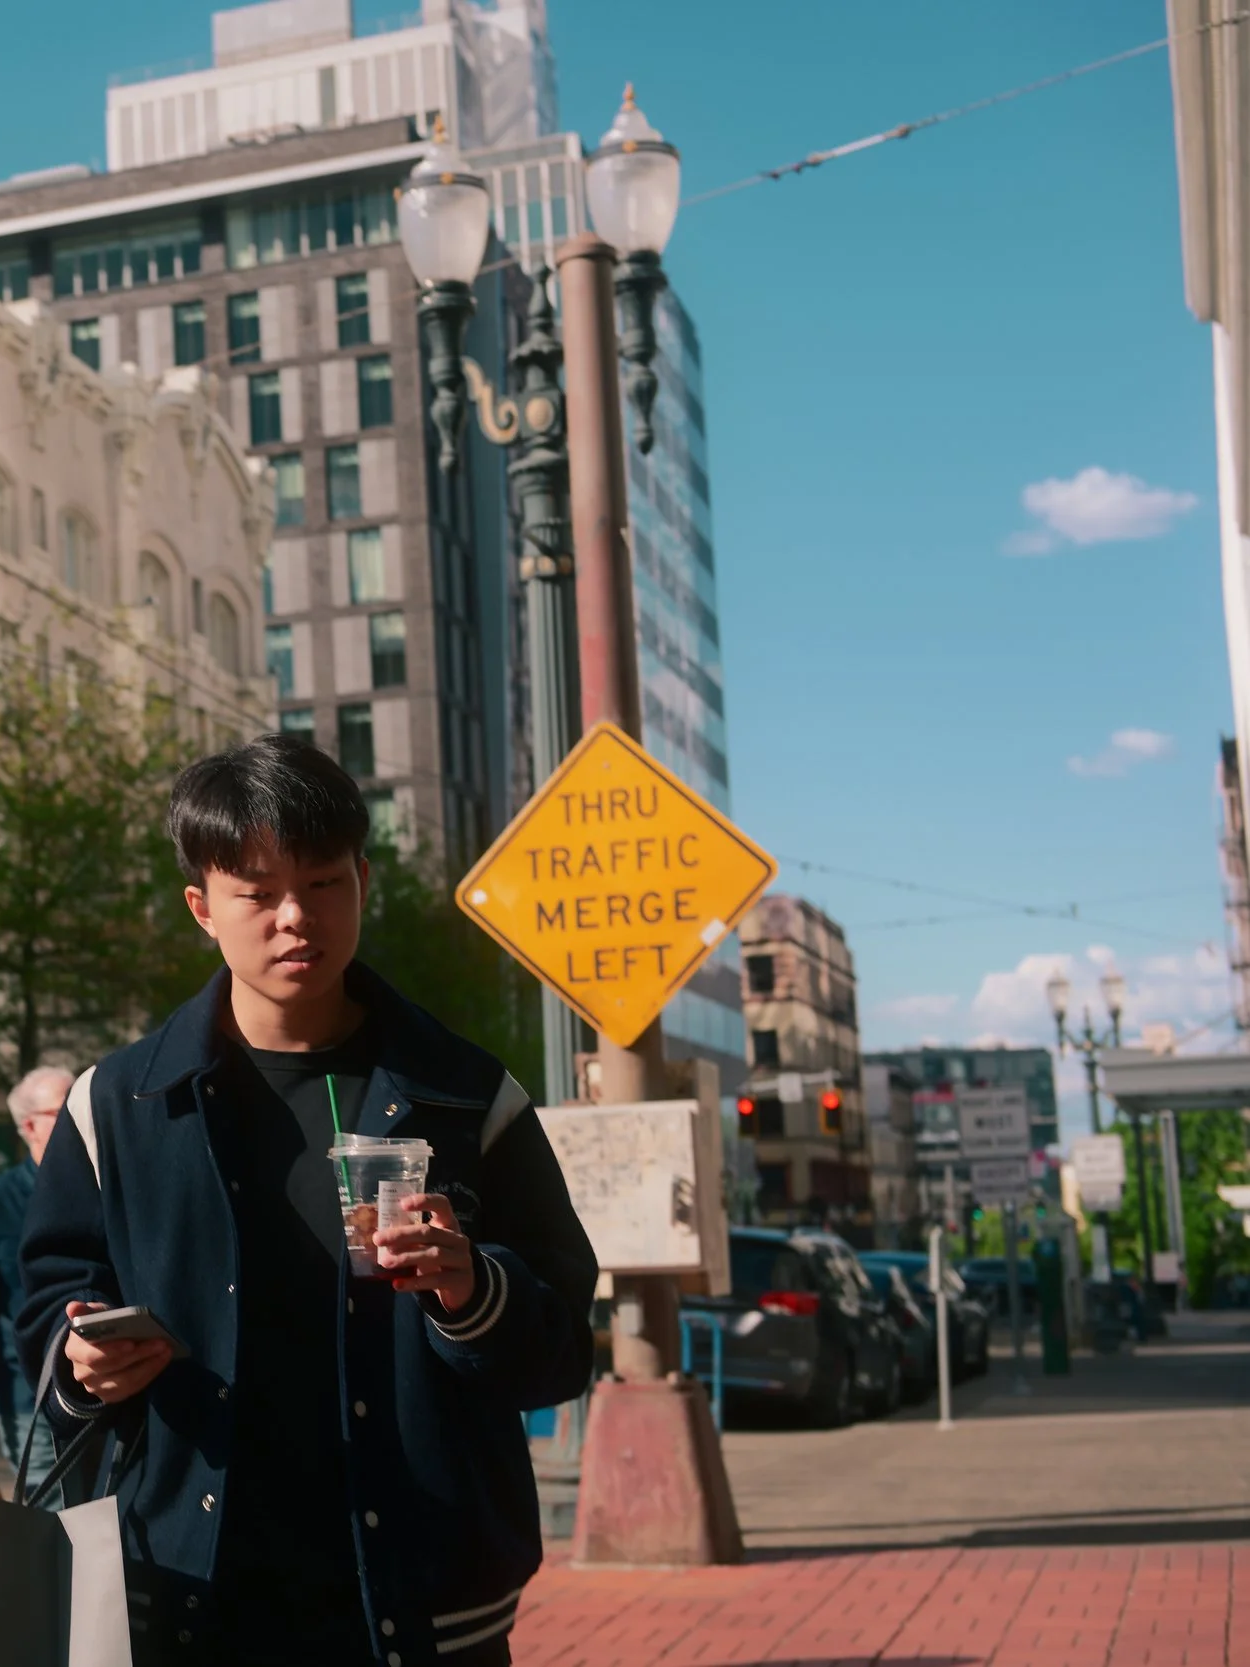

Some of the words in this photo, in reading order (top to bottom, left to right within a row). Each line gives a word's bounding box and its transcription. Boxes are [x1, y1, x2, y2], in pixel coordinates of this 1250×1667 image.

[558, 785, 659, 826] THRU
[526, 833, 700, 881] TRAFFIC
[536, 888, 699, 933] MERGE
[566, 944, 673, 984] LEFT
